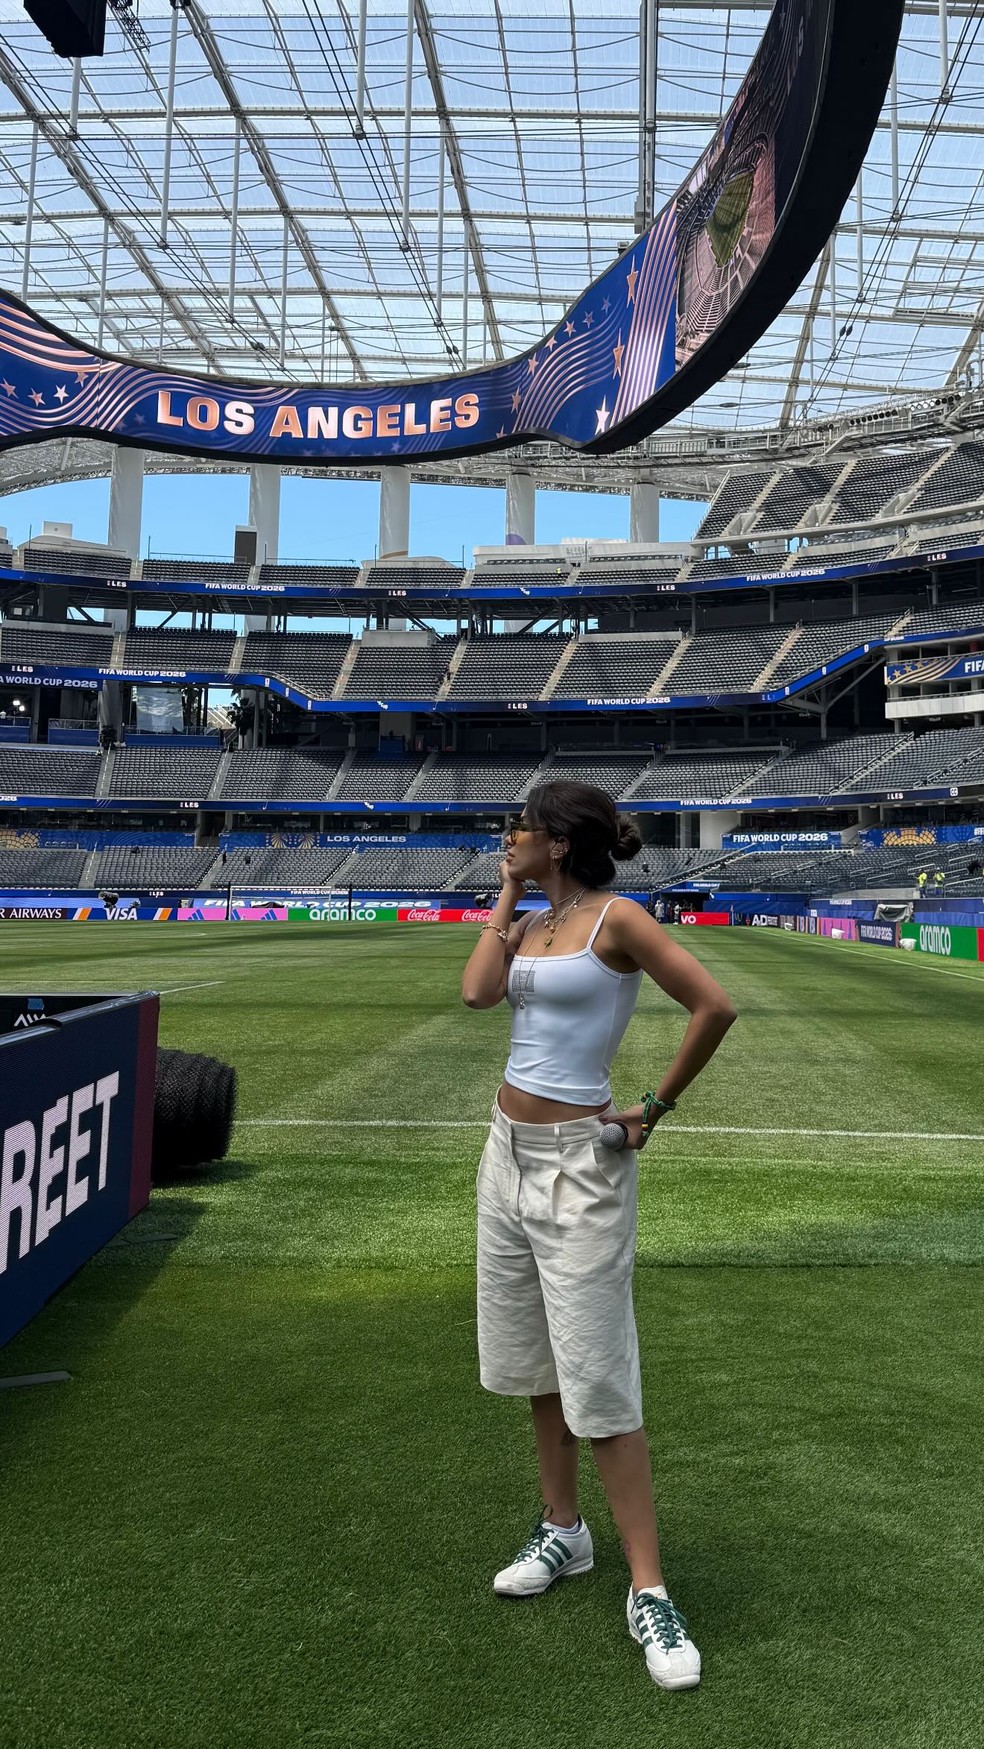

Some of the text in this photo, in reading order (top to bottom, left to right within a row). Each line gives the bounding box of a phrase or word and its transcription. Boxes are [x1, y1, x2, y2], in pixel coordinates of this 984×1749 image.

[157, 390, 480, 439] LOS ANGELES
[762, 572, 786, 580] WORLD
[6, 676, 41, 684] WORLD
[43, 678, 62, 686] CUP
[64, 680, 98, 688] 2026
[751, 834, 780, 842] WORLD
[781, 833, 798, 841] CUP
[798, 833, 828, 841] 2026
[9, 908, 62, 919] AIRWAYS
[104, 908, 137, 920] VISA
[309, 909, 376, 920] aramco
[462, 909, 493, 921] Coca-Col
[920, 925, 951, 955] aramco
